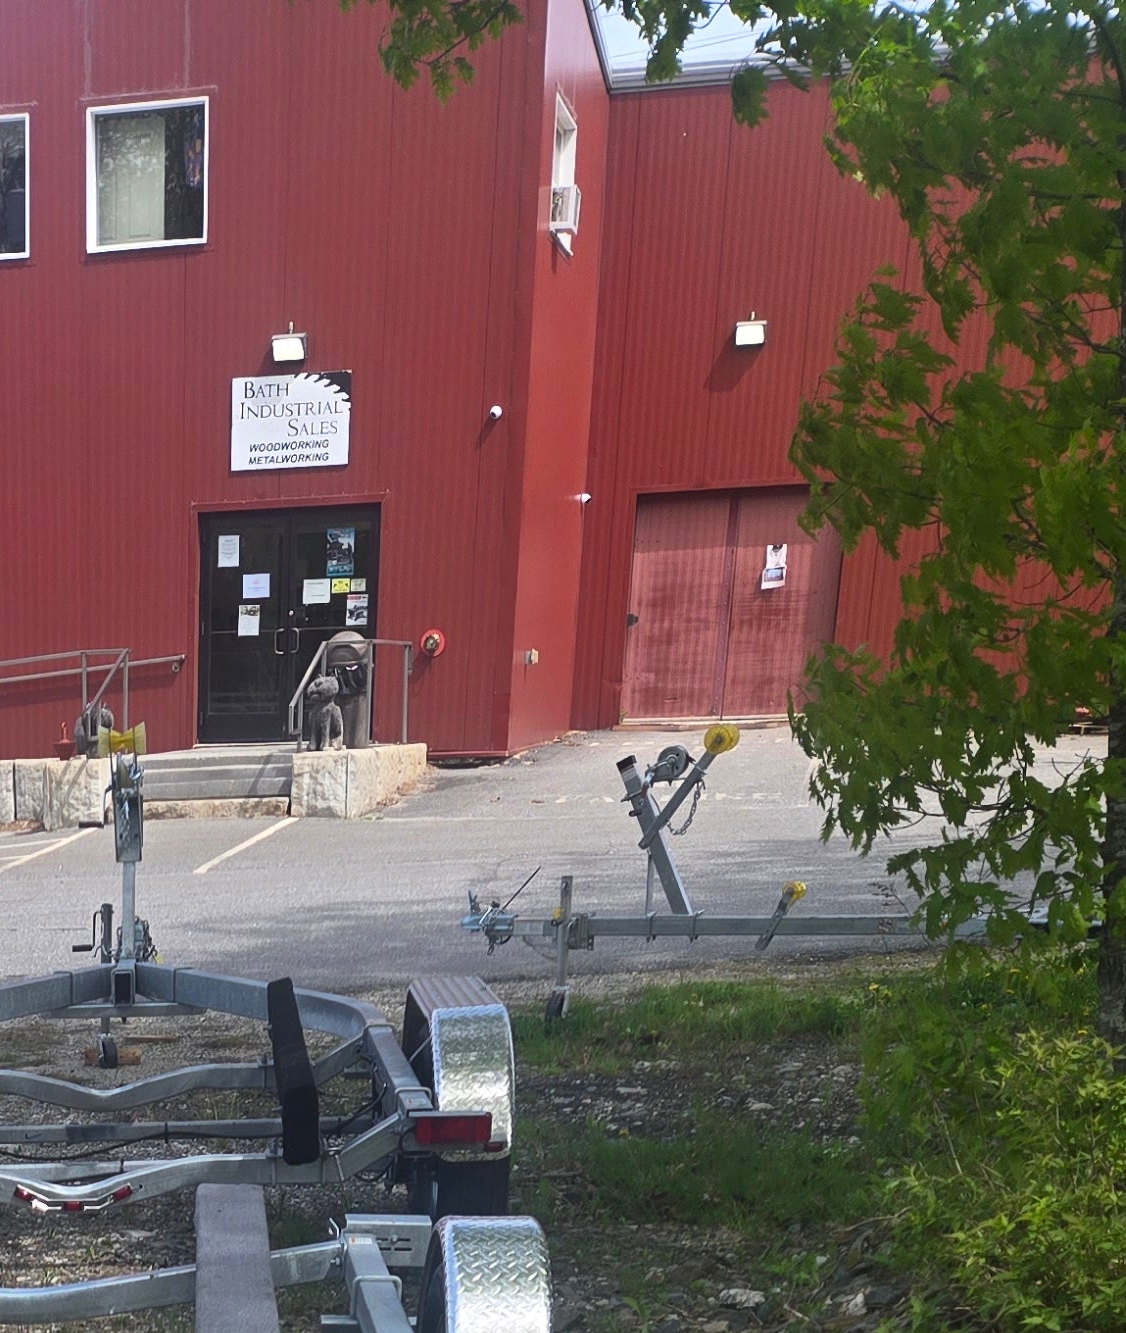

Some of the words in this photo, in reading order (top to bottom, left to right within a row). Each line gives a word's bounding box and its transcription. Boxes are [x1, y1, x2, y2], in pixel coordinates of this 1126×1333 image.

[244, 381, 289, 399] BATH
[240, 401, 343, 420] INDUSTRIAL
[287, 418, 338, 437] SALES
[249, 439, 330, 453] WOODWORKING
[248, 453, 330, 465] METALWORKING
